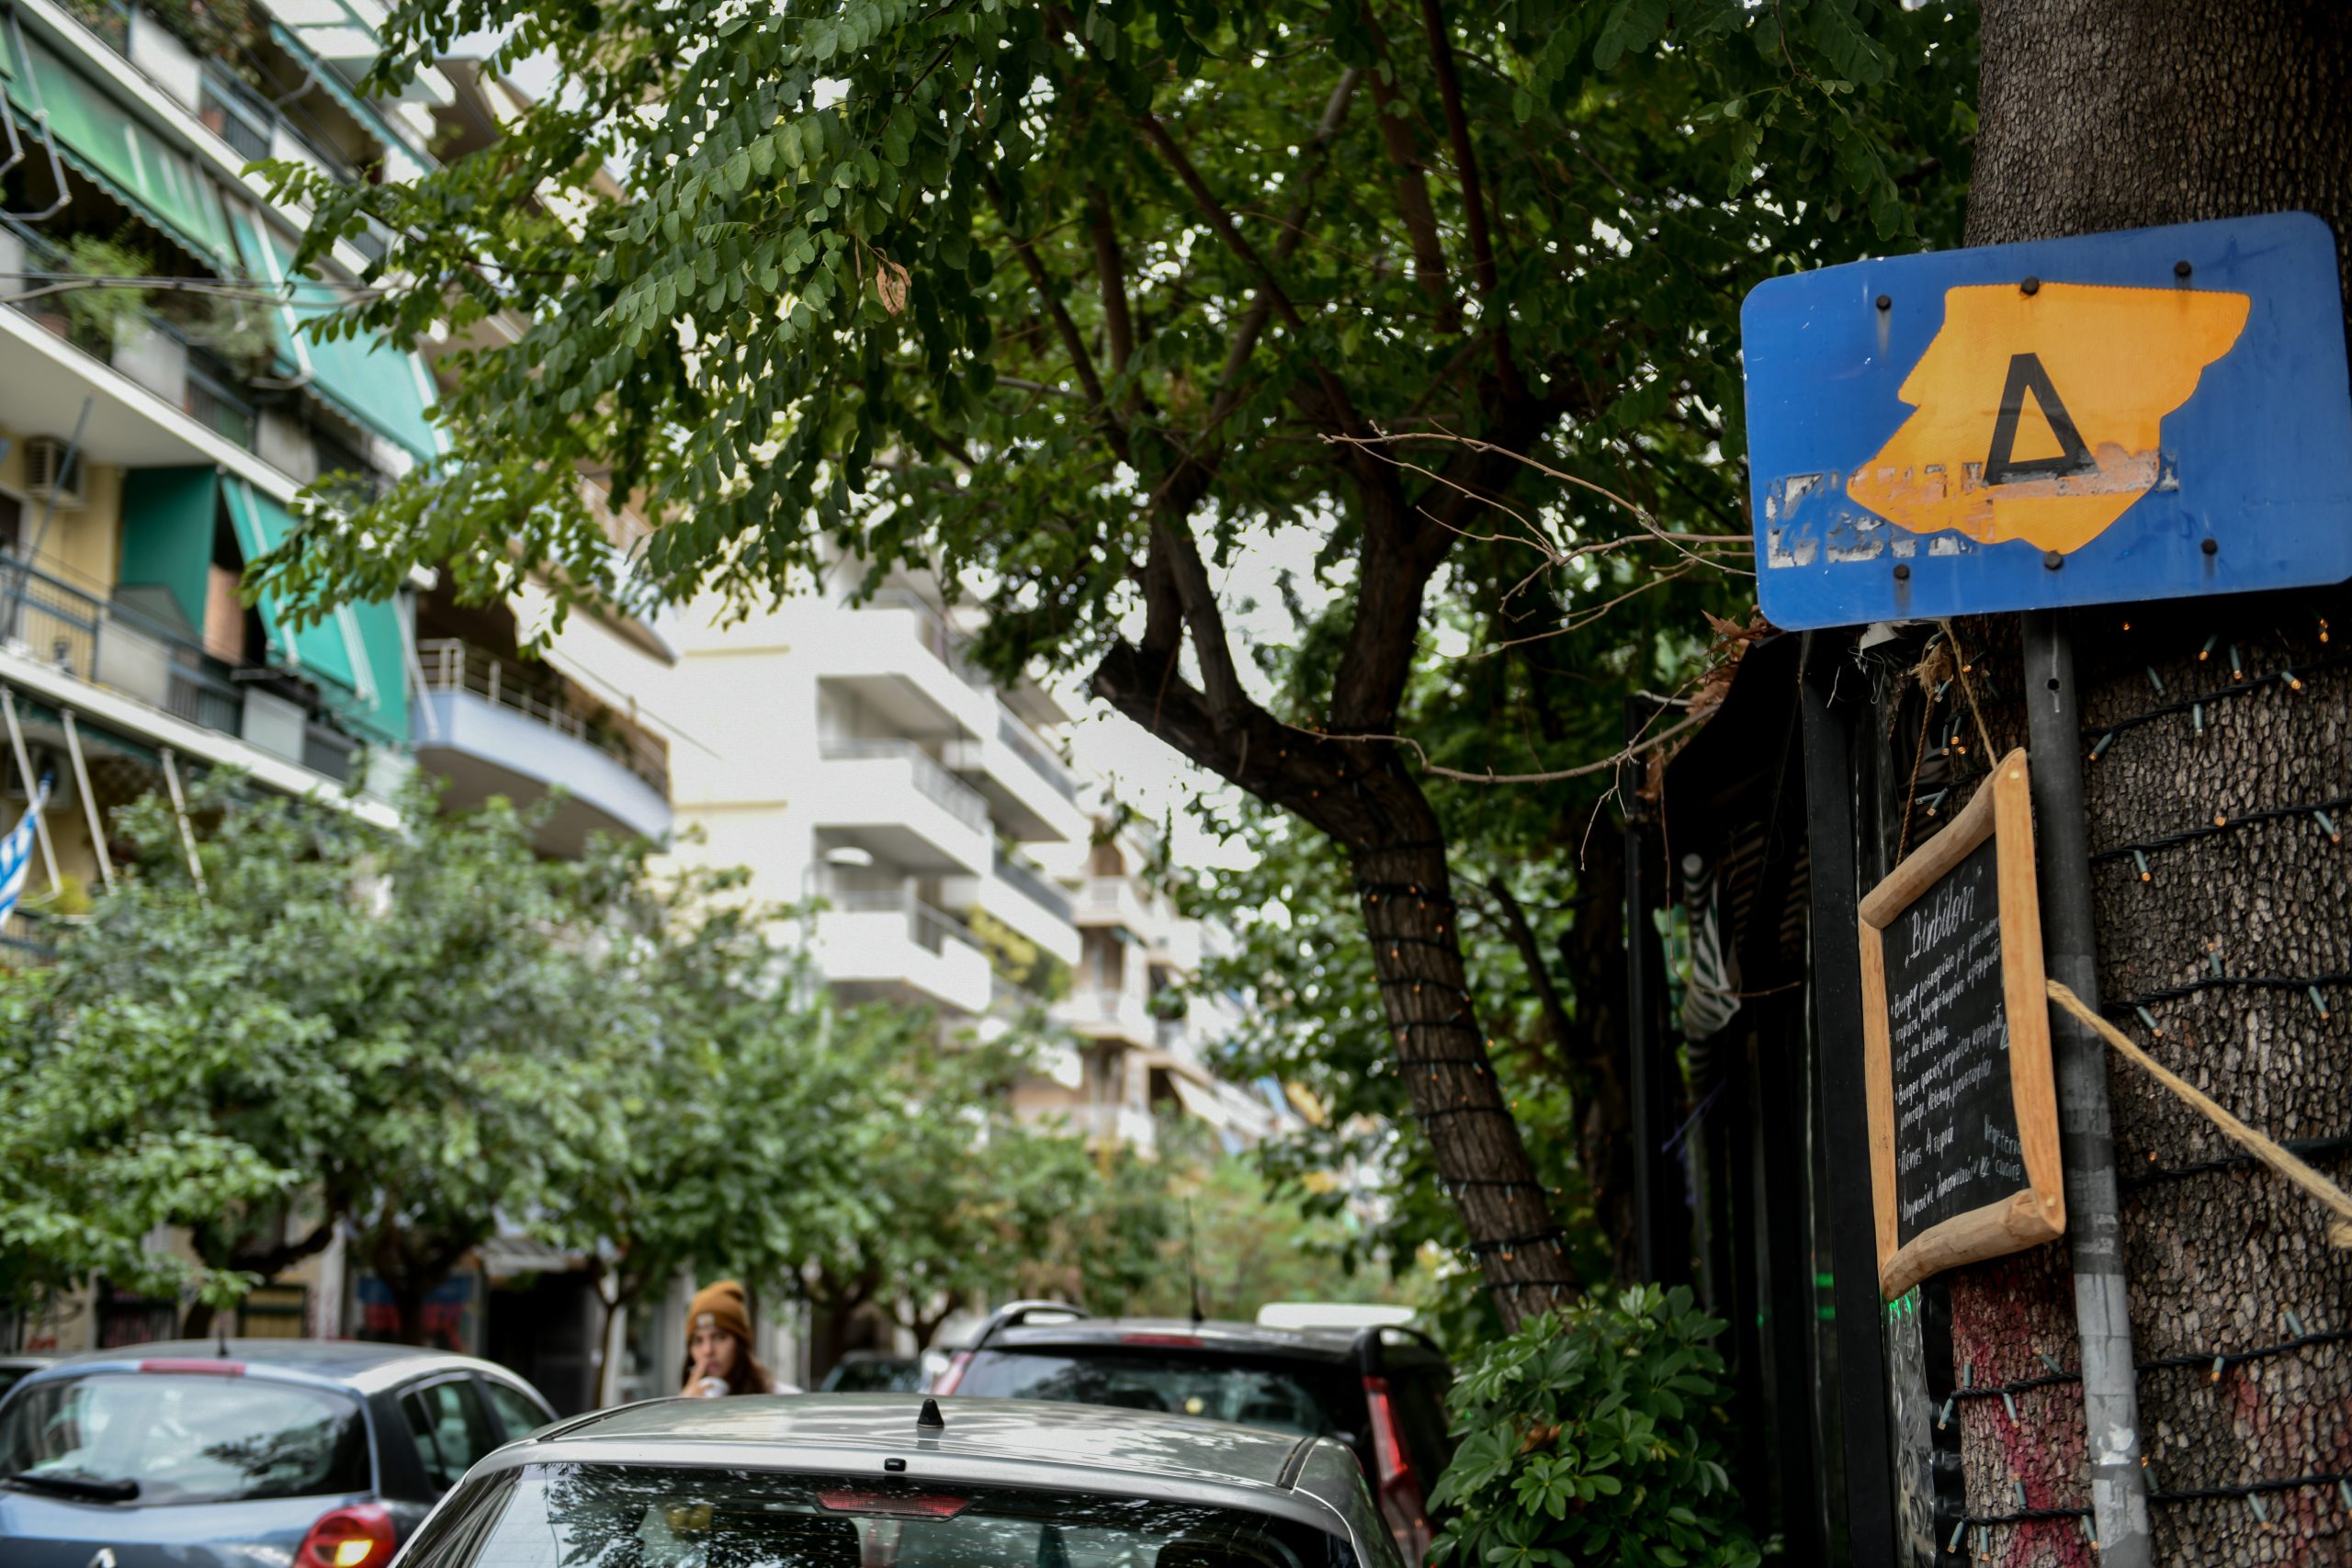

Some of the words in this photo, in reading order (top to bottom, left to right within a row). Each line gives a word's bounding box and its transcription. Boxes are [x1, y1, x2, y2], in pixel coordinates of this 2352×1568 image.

[1983, 353, 2101, 486] Δ
[1894, 983, 1918, 1019] Burger
[1898, 1079, 1919, 1106] Burger
[1926, 1127, 1932, 1156] 4
